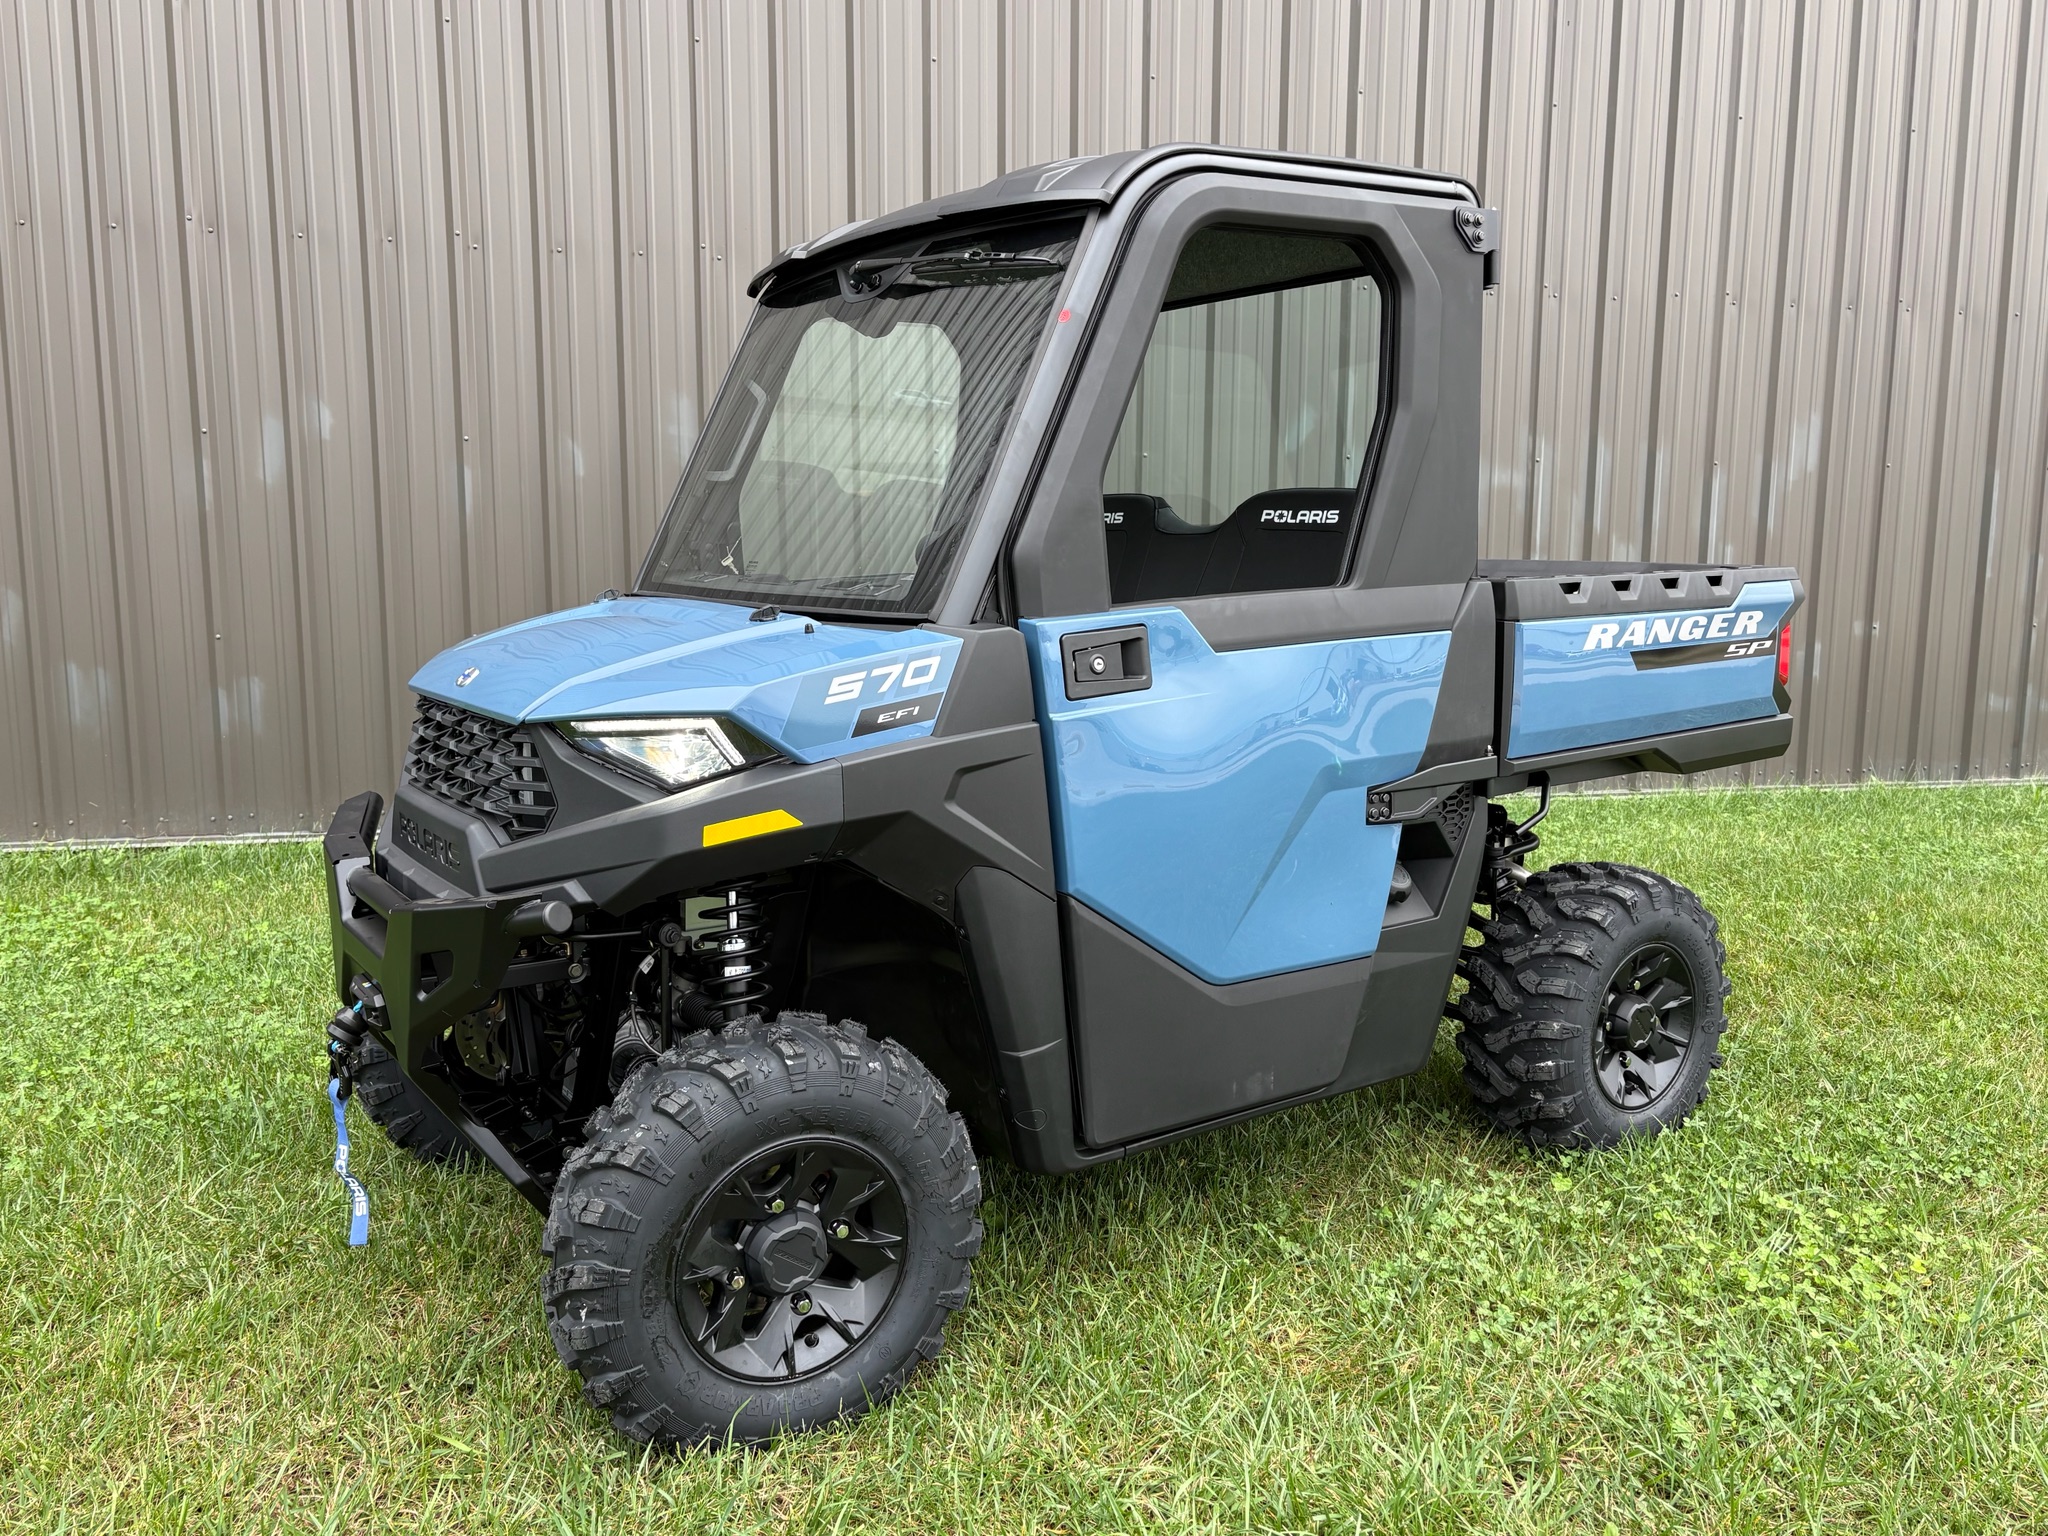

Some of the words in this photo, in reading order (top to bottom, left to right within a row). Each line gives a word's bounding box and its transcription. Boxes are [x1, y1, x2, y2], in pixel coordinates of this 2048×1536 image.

[1261, 509, 1339, 524] POLARIS
[1583, 610, 1764, 651] RANGER
[1724, 640, 1773, 657] SP
[824, 655, 941, 705] 570
[877, 706, 920, 724] EFI
[399, 812, 460, 872] POLARIS
[335, 1144, 367, 1217] POLARIS
